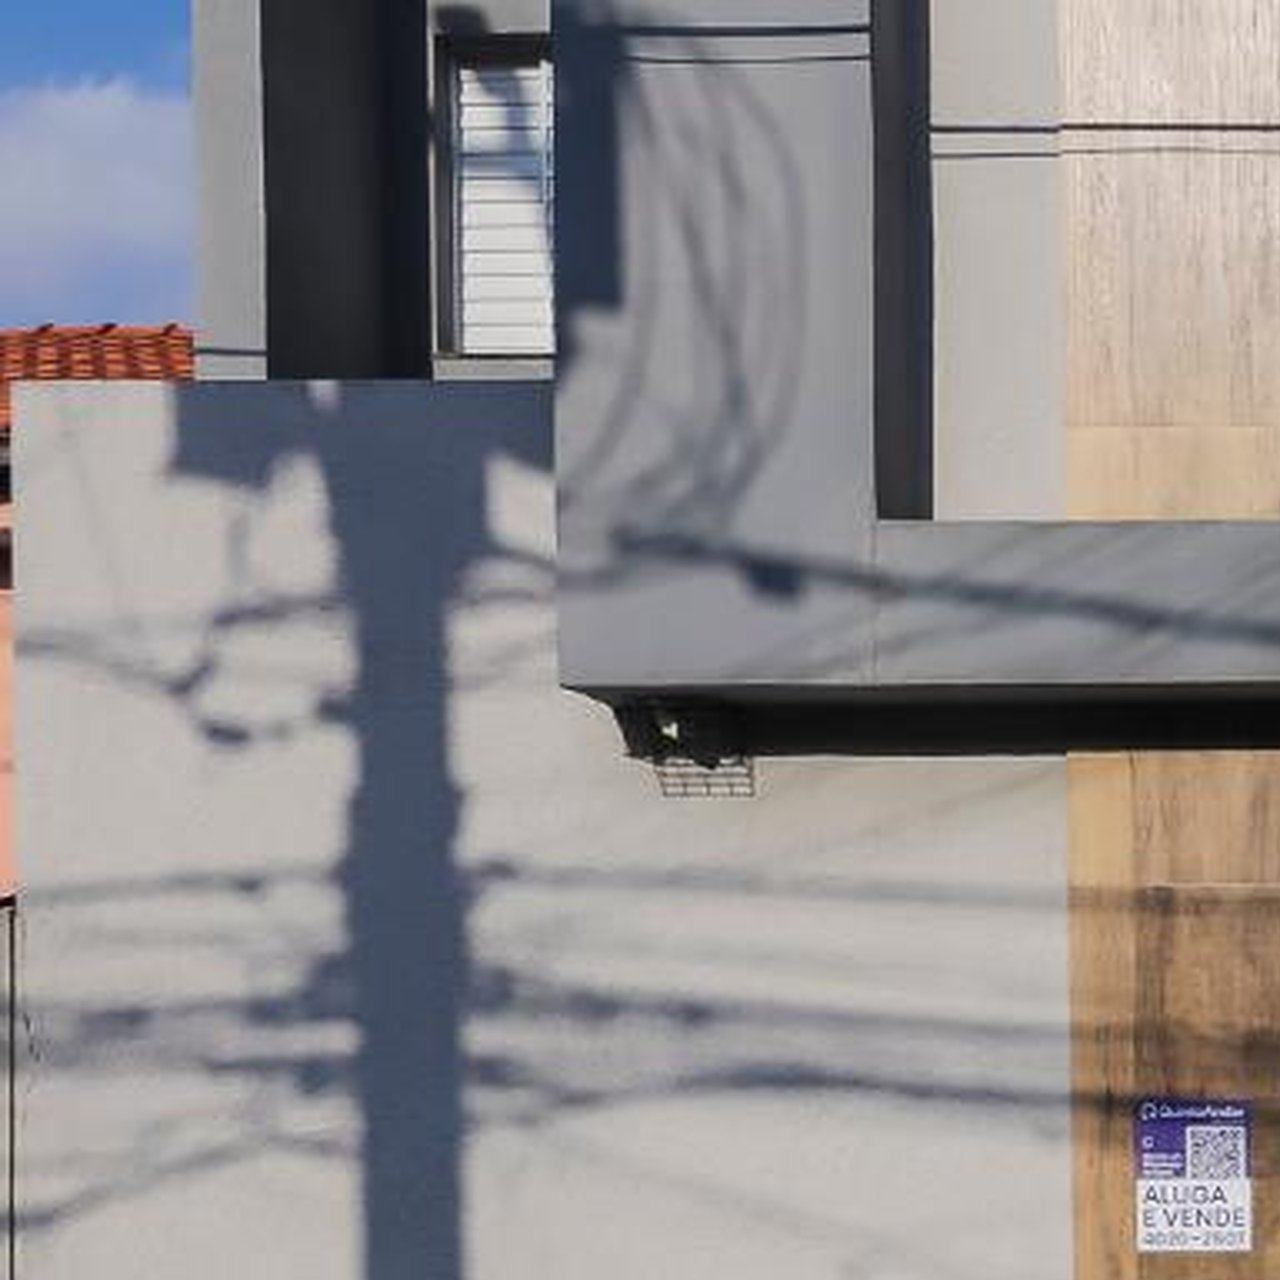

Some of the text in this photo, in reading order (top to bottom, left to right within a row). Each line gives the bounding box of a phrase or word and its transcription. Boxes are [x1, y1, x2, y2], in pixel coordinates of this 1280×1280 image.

[1142, 1185, 1229, 1205] ALUGA
[1142, 1207, 1246, 1229] E VENDE
